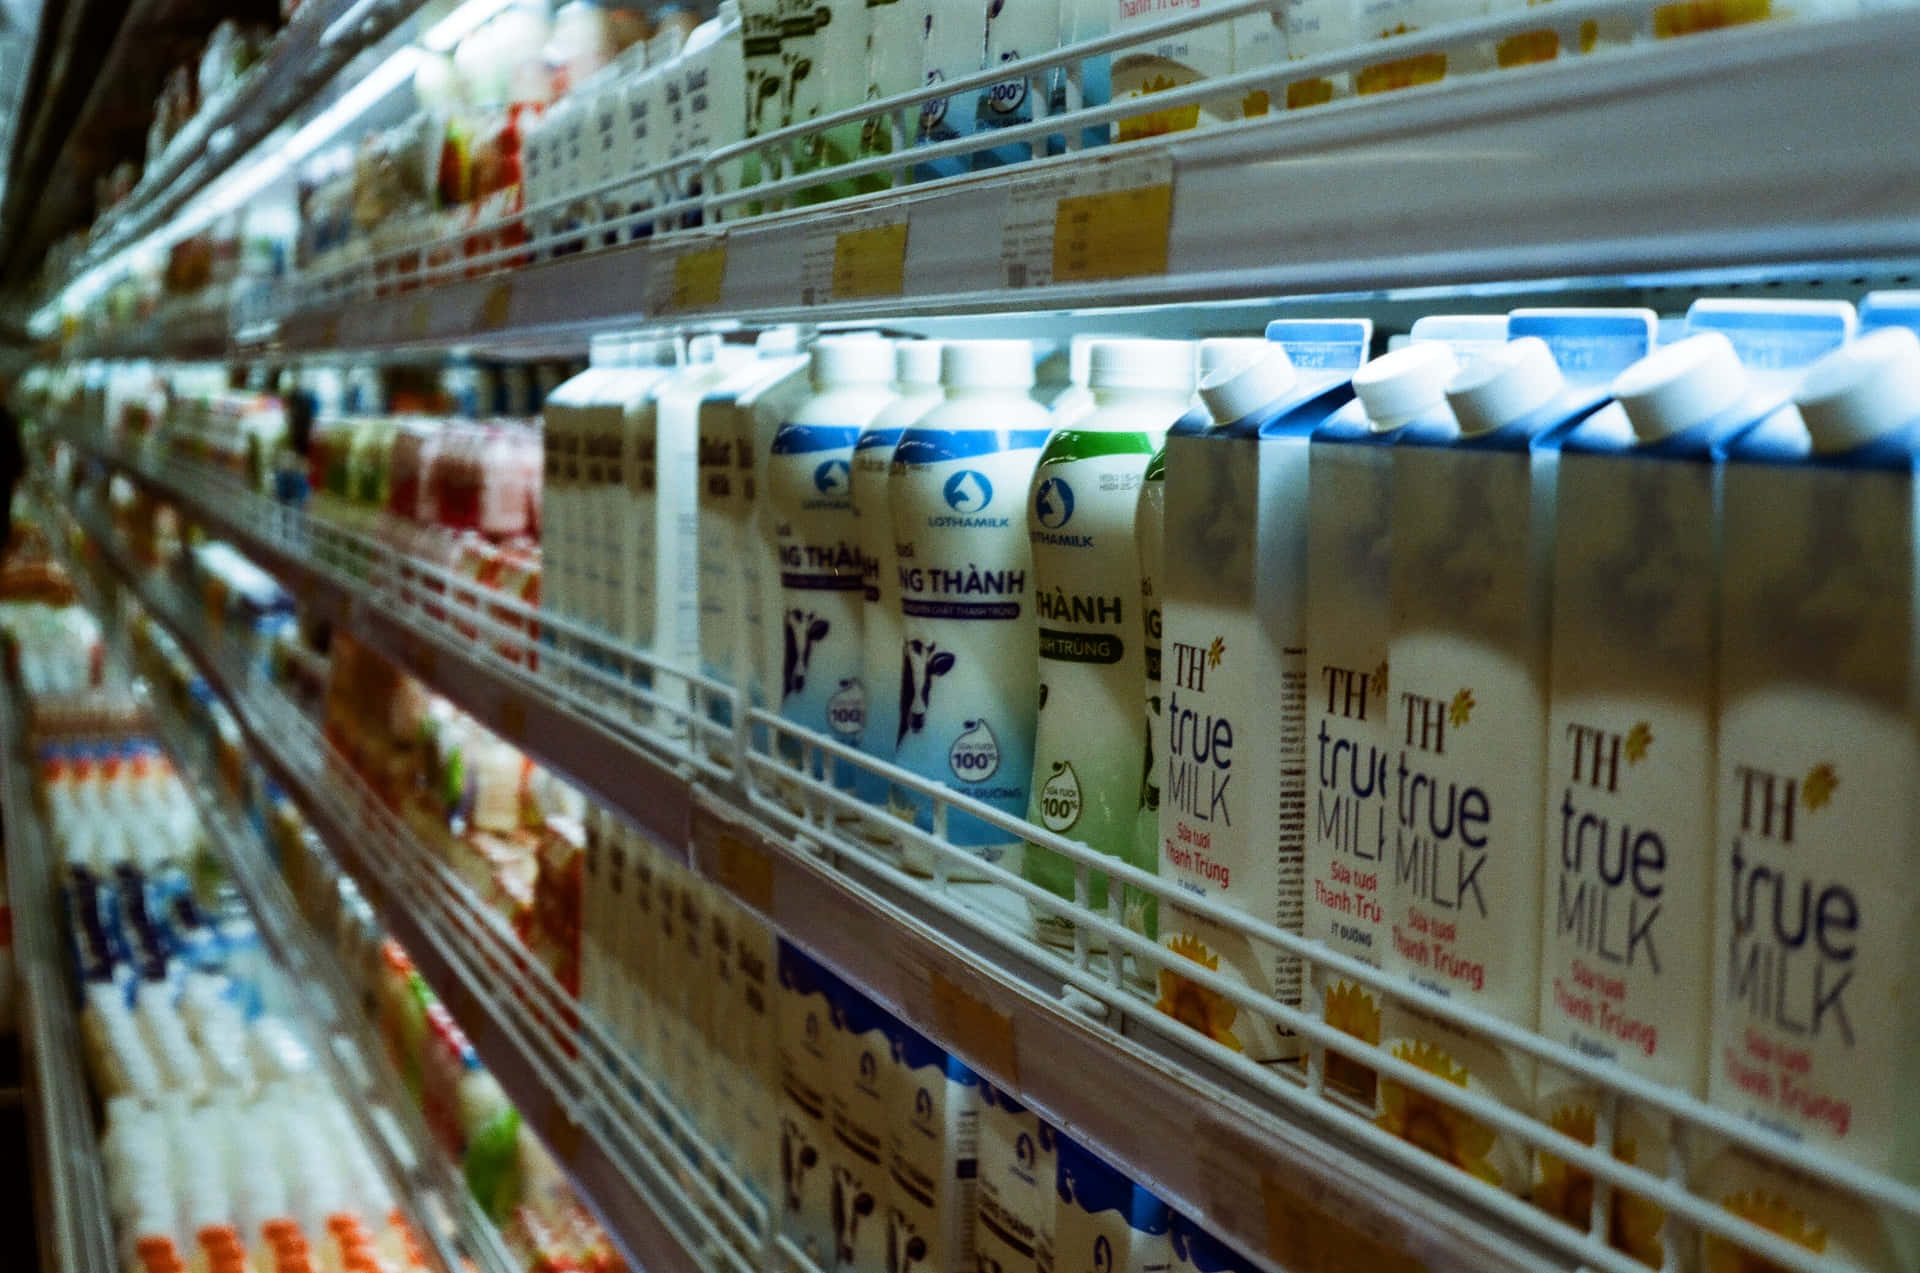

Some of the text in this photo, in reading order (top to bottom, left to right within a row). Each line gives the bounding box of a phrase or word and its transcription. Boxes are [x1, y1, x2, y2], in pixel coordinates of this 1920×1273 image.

[928, 517, 1009, 528] LOTHAMILK
[928, 562, 1025, 594] THÀNH
[1058, 636, 1111, 657] TRÙNG
[1173, 642, 1206, 693] TH
[1322, 665, 1371, 720] TH
[1401, 692, 1445, 754] TH
[1169, 691, 1233, 770] true
[1318, 719, 1387, 798] tru
[1566, 721, 1621, 793] TH
[1168, 756, 1232, 827] MILK
[1317, 789, 1385, 862] MIL
[1397, 750, 1490, 848] true
[1735, 763, 1797, 845] TH
[1166, 839, 1192, 870] Thanh
[1395, 827, 1488, 919] MILK
[1561, 787, 1666, 899] true
[1315, 877, 1351, 914] Thanh
[1557, 871, 1661, 976] MILK
[1731, 836, 1859, 963] true
[1728, 932, 1857, 1049] MILK
